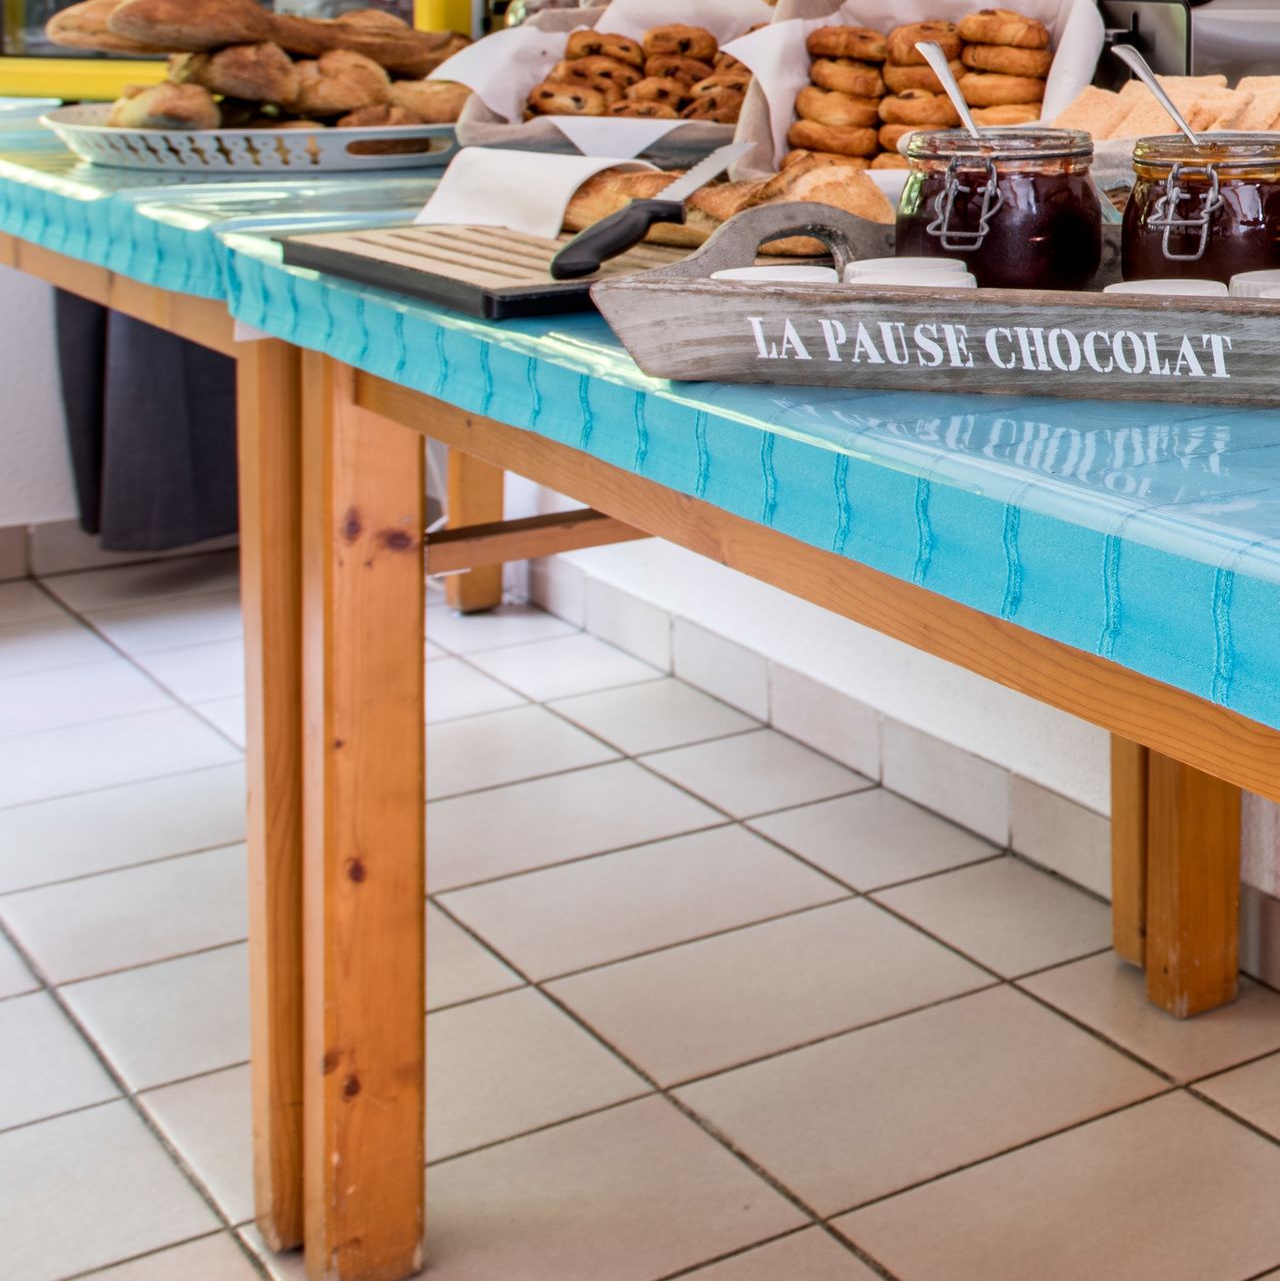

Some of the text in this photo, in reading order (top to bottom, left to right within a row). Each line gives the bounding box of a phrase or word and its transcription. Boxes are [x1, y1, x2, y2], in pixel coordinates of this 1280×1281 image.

[748, 316, 1233, 379] LA PAUSE CHOCOLAT
